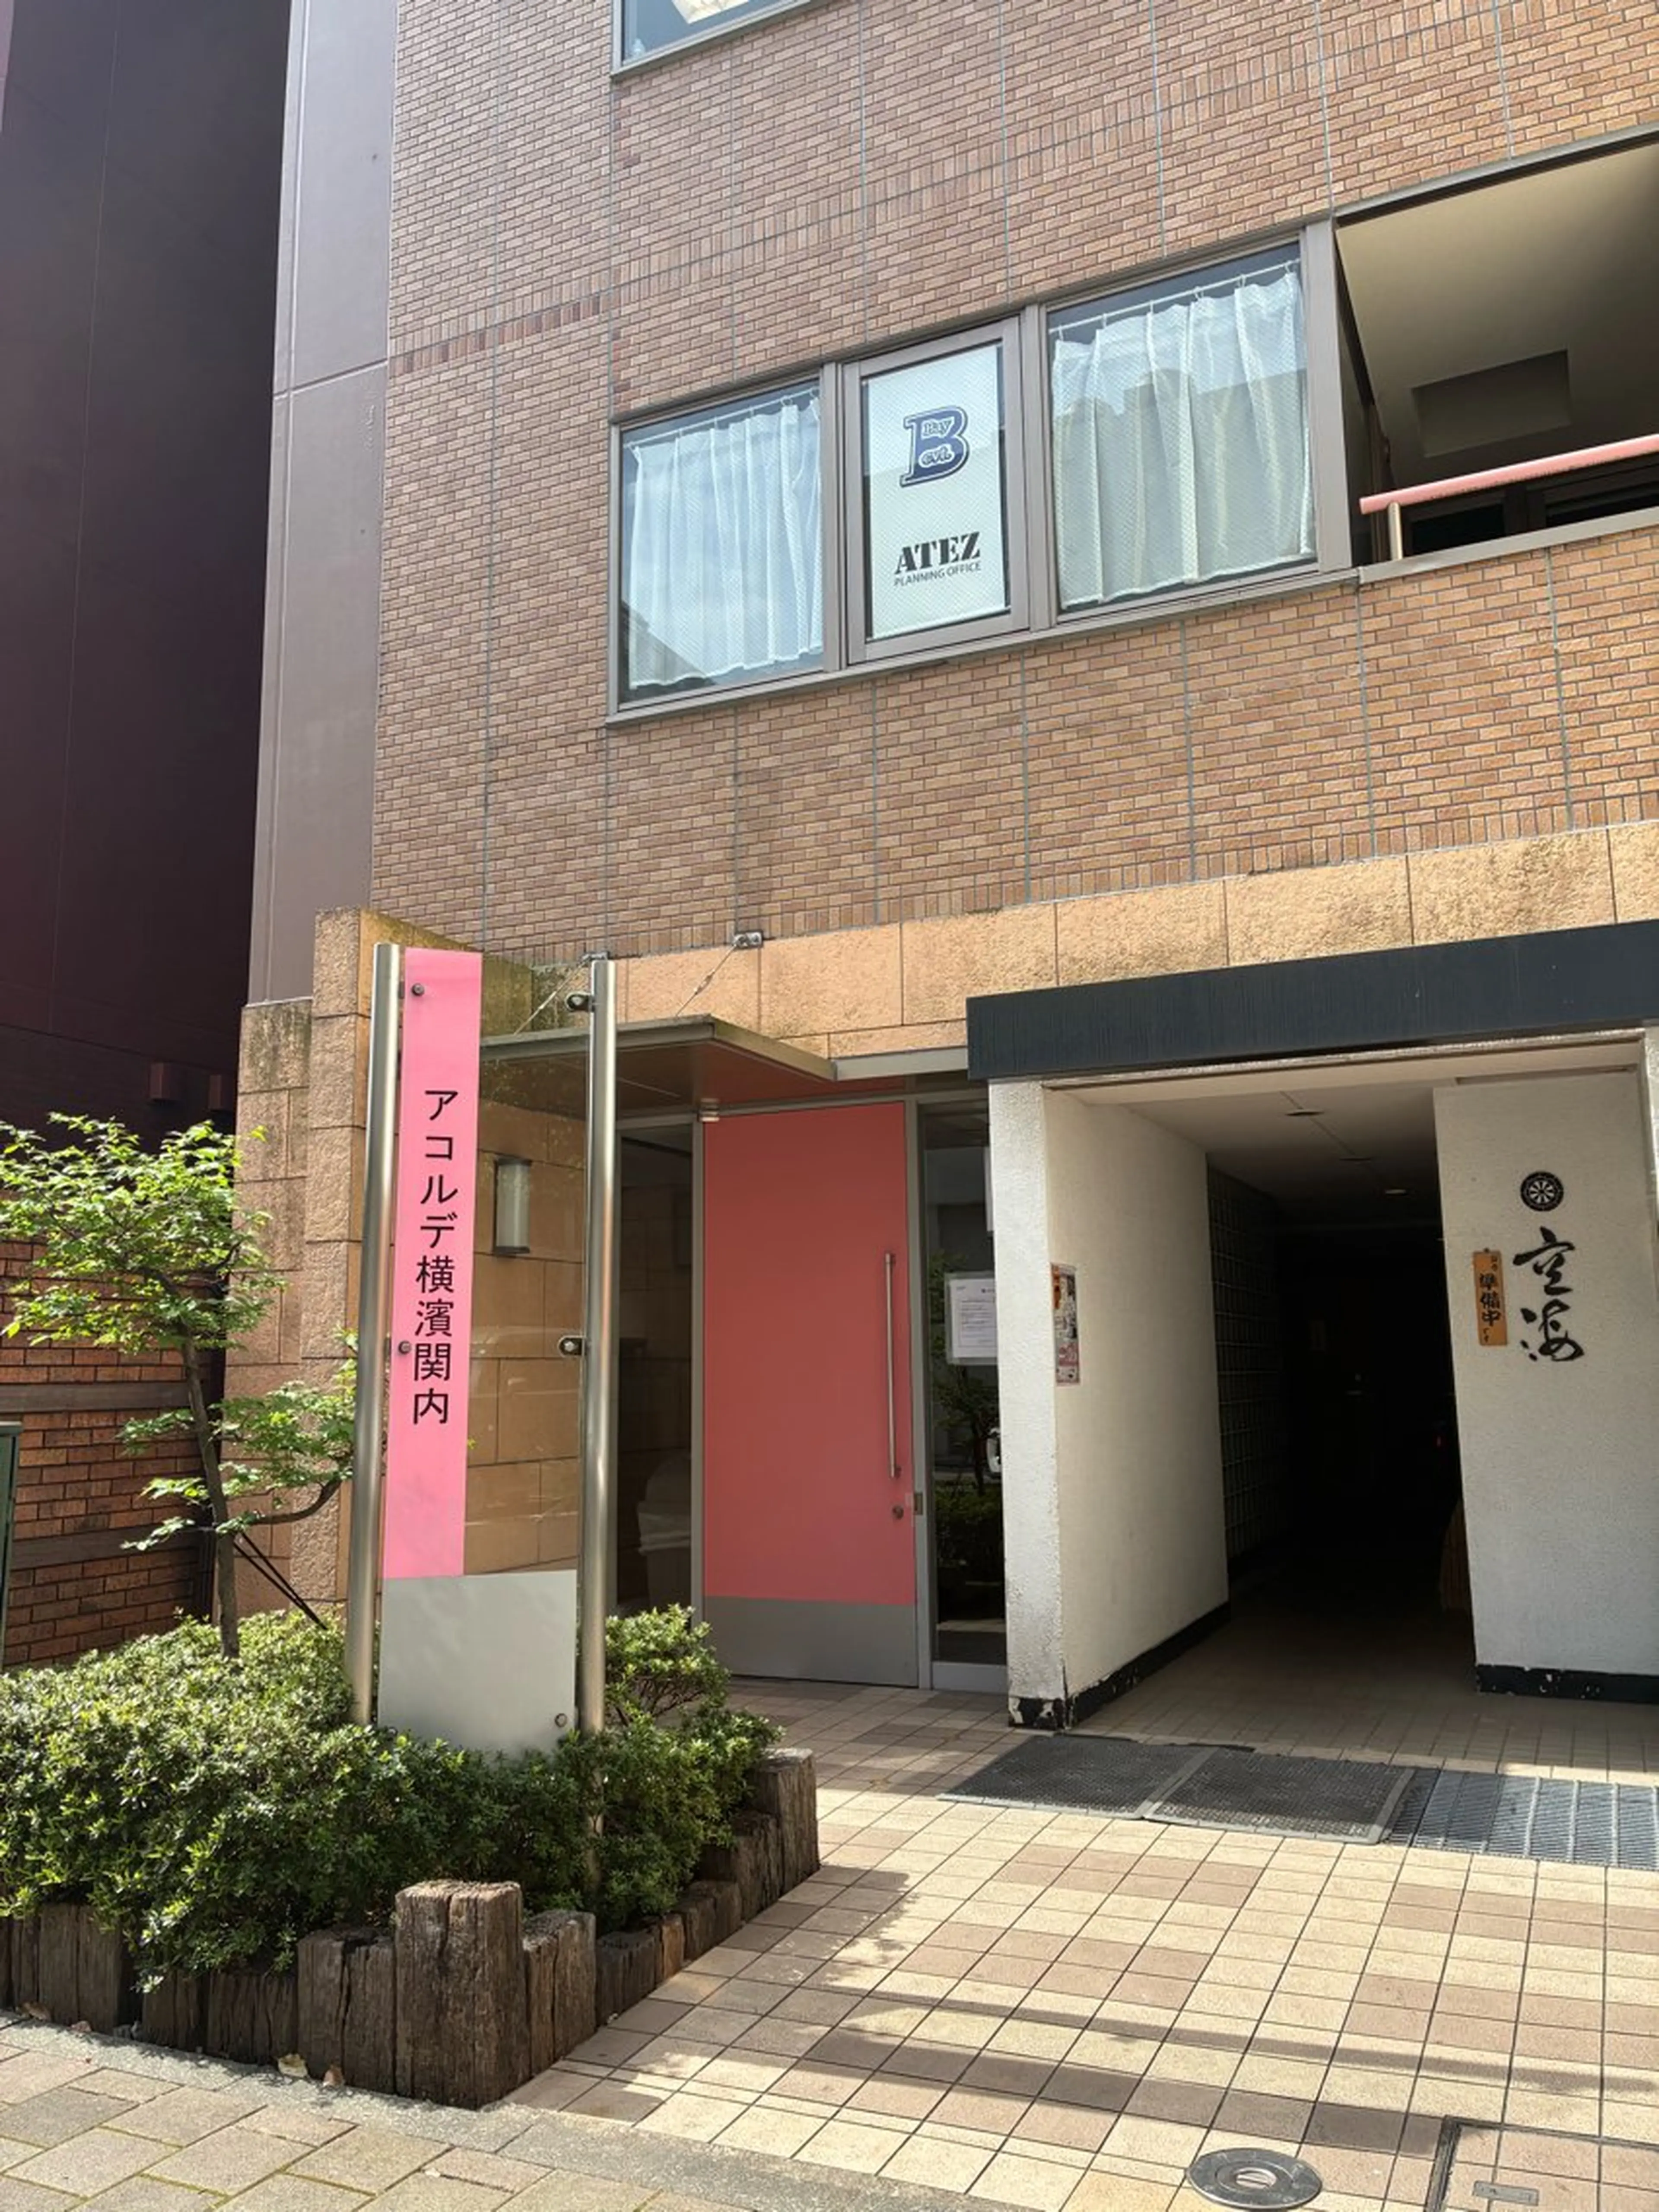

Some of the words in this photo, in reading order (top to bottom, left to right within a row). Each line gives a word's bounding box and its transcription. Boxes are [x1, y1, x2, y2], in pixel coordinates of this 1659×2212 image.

[894, 531, 980, 574] ATEZ
[894, 568, 945, 586] PLANNING
[946, 563, 981, 577] OFFICE
[413, 1089, 458, 1425] アコルデ横濱関内
